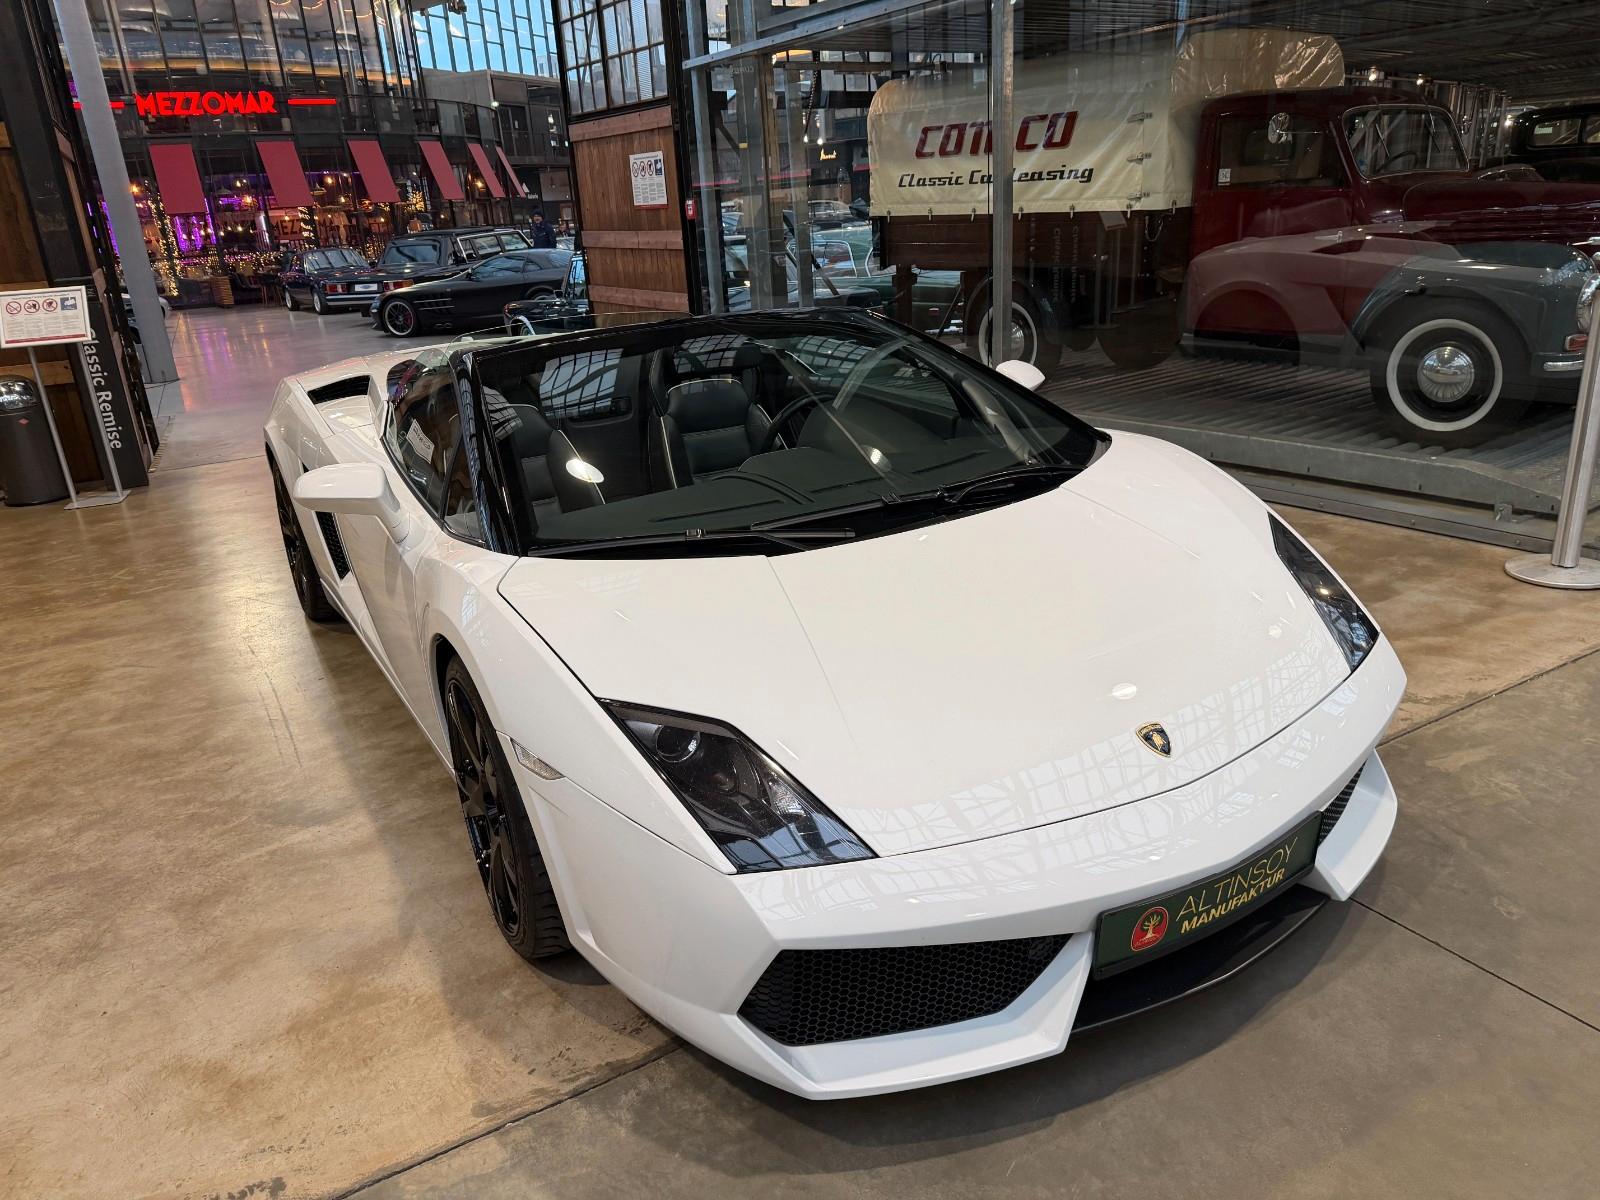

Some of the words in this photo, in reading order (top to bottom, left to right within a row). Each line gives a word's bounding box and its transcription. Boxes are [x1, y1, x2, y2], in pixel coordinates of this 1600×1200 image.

[135, 91, 277, 117] MEZZOMAR
[898, 171, 964, 188] Classic
[968, 169, 993, 184] Ca
[96, 390, 122, 449] Remise
[1175, 836, 1298, 922] ALTINSOY
[1180, 868, 1286, 934] MANUFAKTUR
